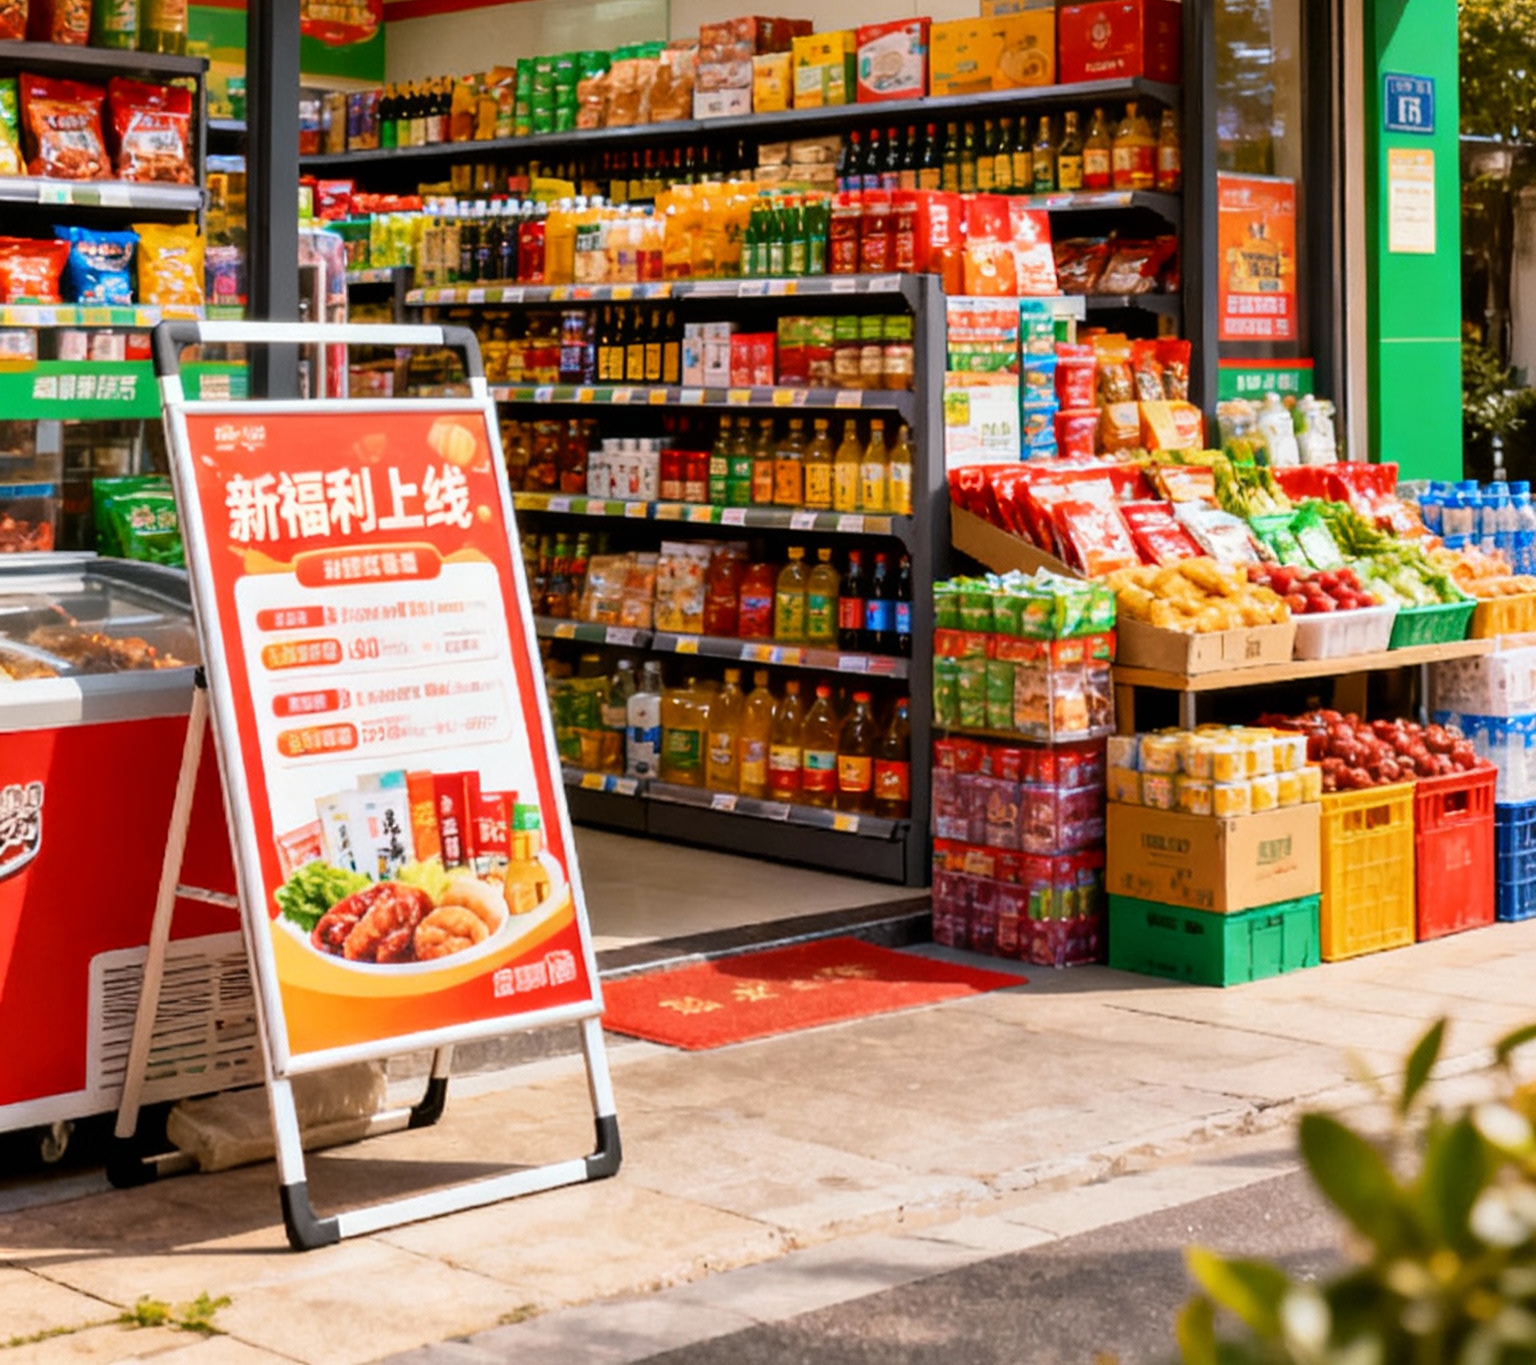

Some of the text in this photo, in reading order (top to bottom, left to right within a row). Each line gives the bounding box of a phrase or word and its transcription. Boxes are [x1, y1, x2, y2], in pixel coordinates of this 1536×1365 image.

[225, 464, 473, 542] 新福利上线
